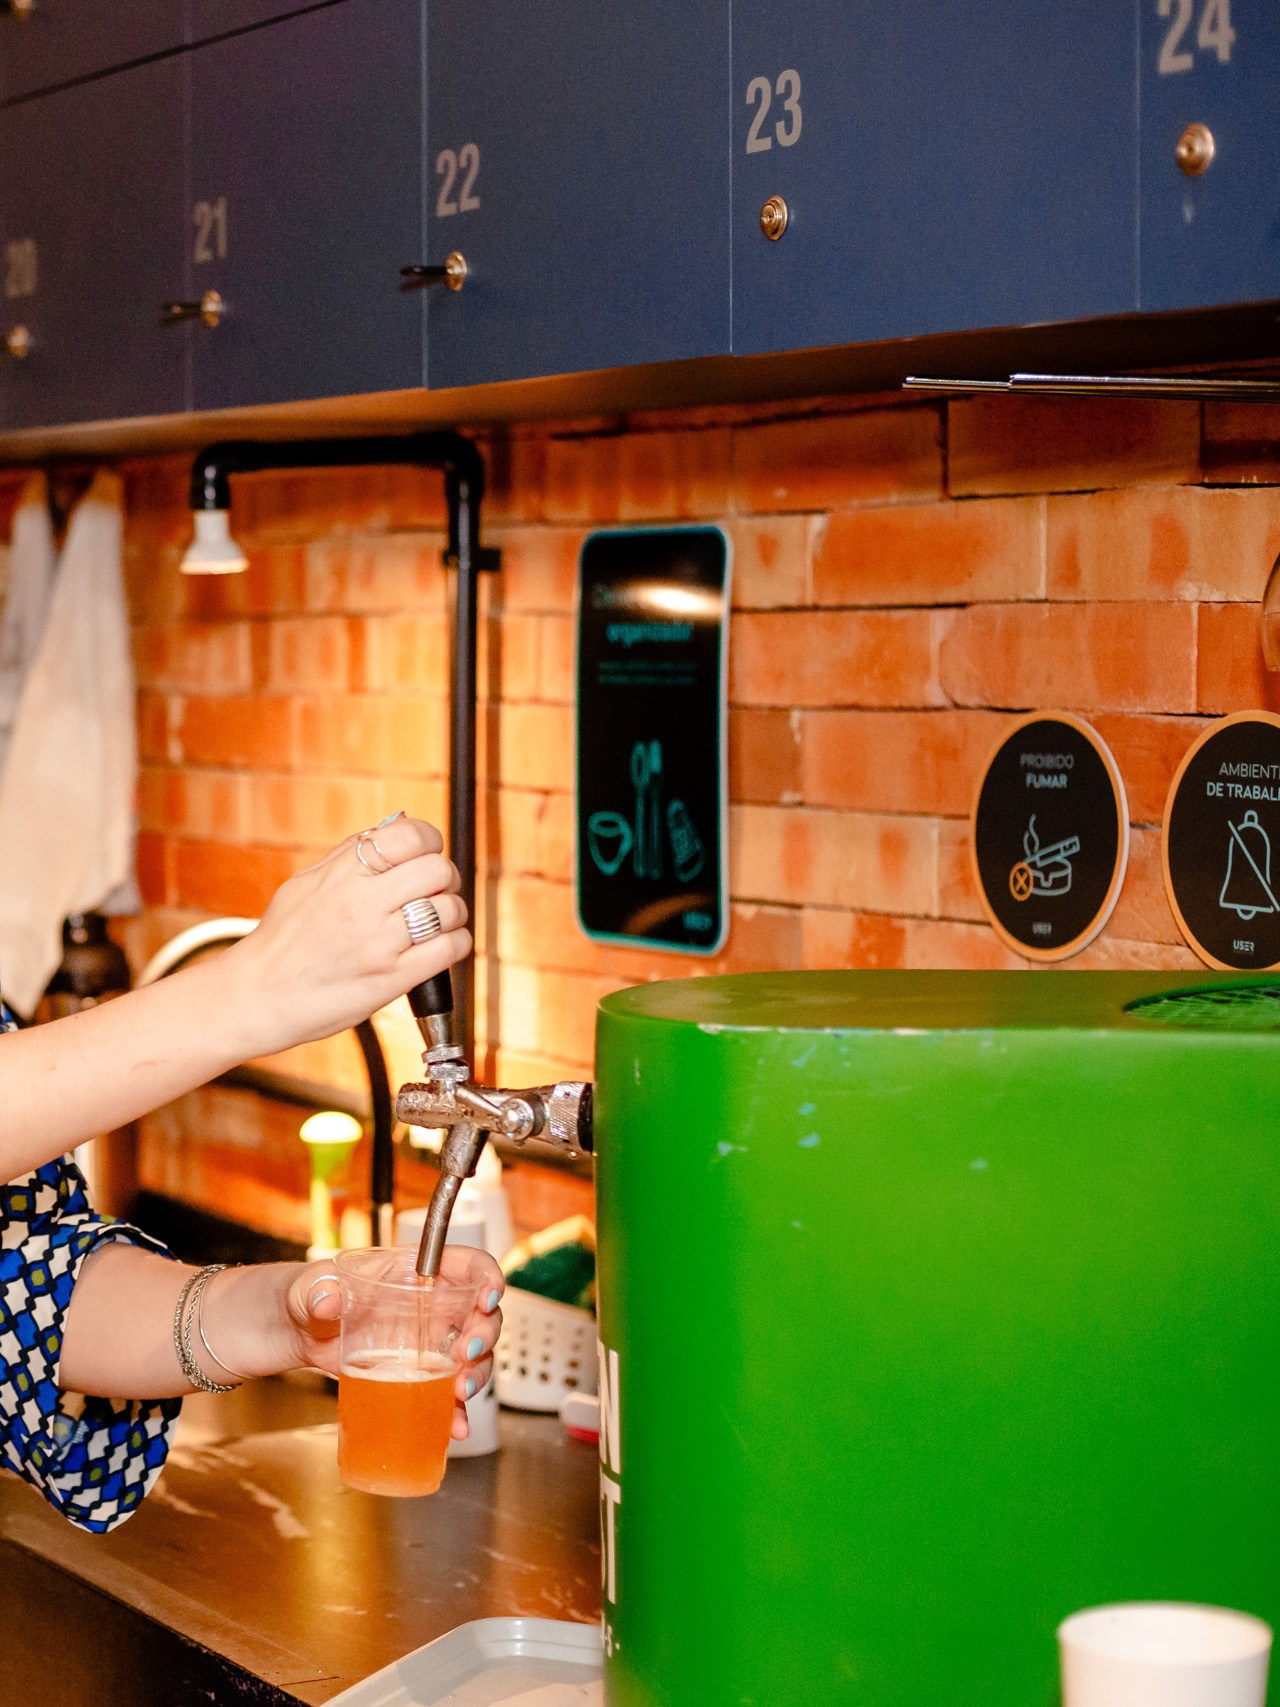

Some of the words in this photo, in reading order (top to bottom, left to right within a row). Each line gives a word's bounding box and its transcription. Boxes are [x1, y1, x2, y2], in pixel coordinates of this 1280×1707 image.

[1158, 0, 1236, 74] 24
[745, 69, 803, 154] 23
[436, 143, 480, 217] 22
[194, 196, 227, 262] 21
[1026, 772, 1068, 789] FUMAR
[1206, 781, 1224, 797] DE
[1219, 762, 1280, 780] AMBIENT
[1233, 940, 1255, 952] USER
